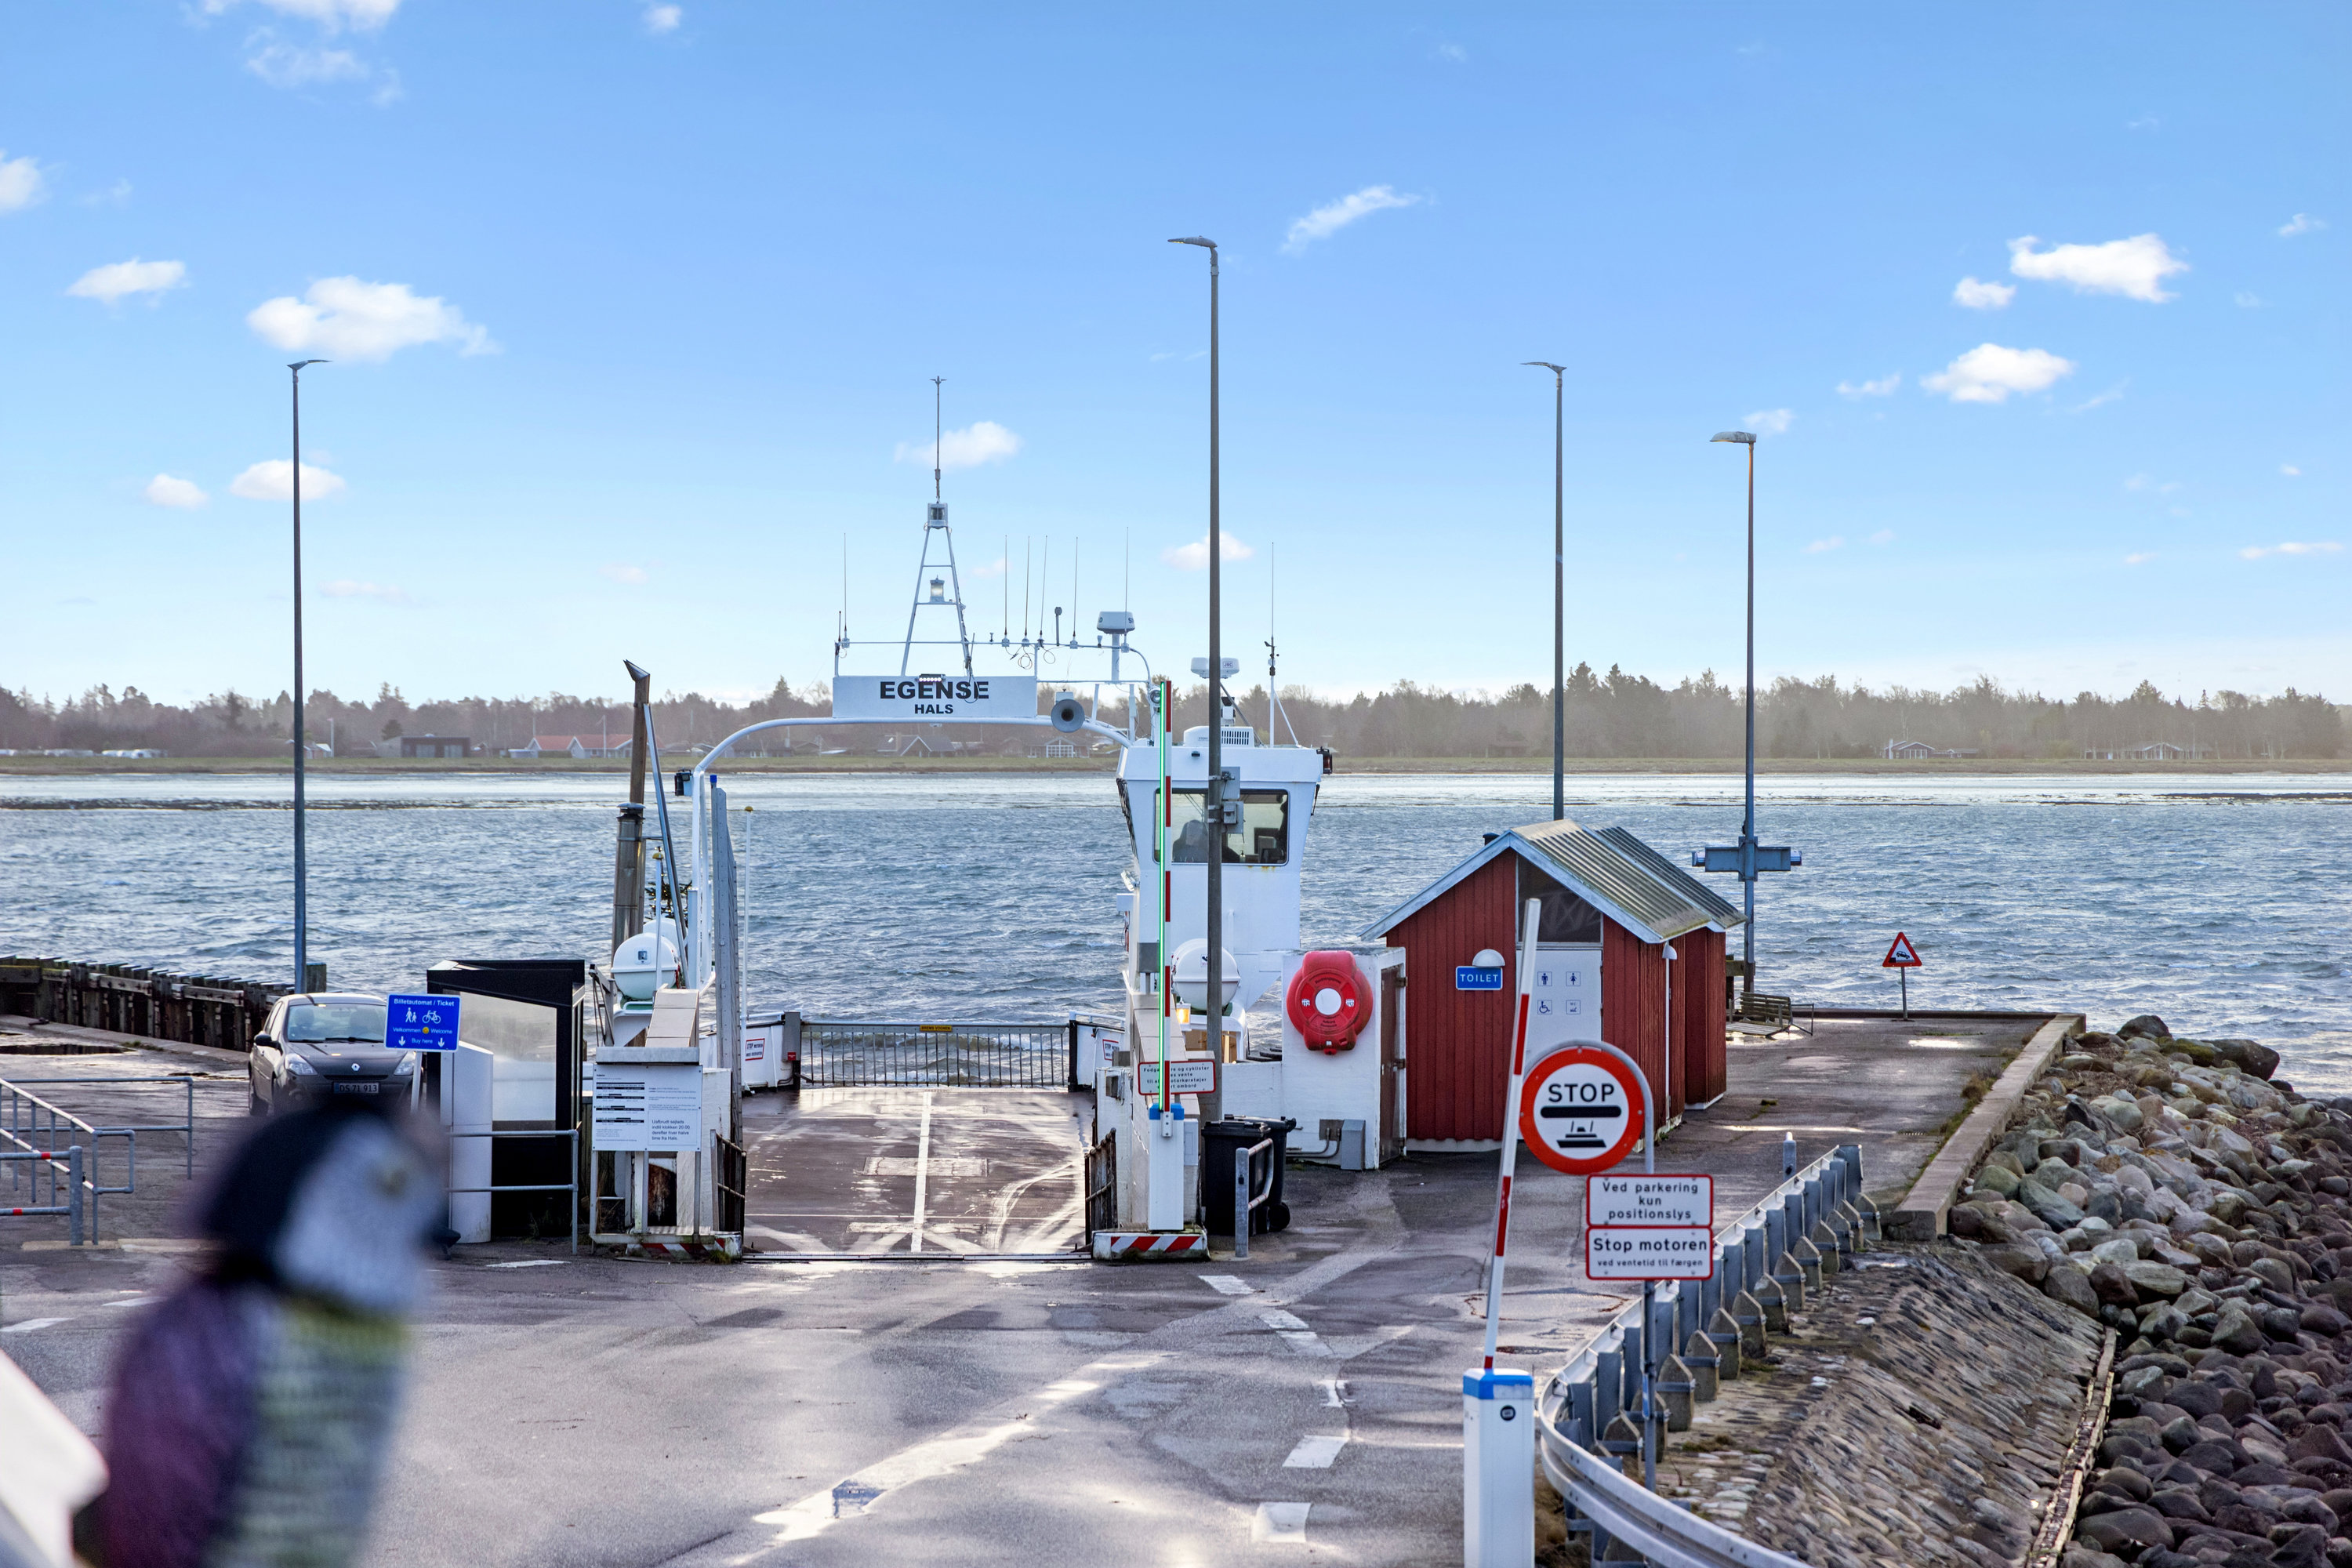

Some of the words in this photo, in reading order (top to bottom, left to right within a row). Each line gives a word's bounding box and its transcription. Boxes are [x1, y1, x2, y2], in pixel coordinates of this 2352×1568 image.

[880, 681, 989, 699] EGENSE
[914, 704, 954, 714] HALS
[1460, 974, 1498, 982] TOILET
[1548, 1083, 1615, 1102] STOP
[1602, 1182, 1627, 1192] Ved
[1635, 1182, 1698, 1194] parkering
[1639, 1196, 1661, 1205] kun
[1609, 1209, 1691, 1220] positionslys
[1593, 1238, 1632, 1253] Stop
[1639, 1238, 1707, 1251] motoren
[1671, 1259, 1703, 1268] færgen
